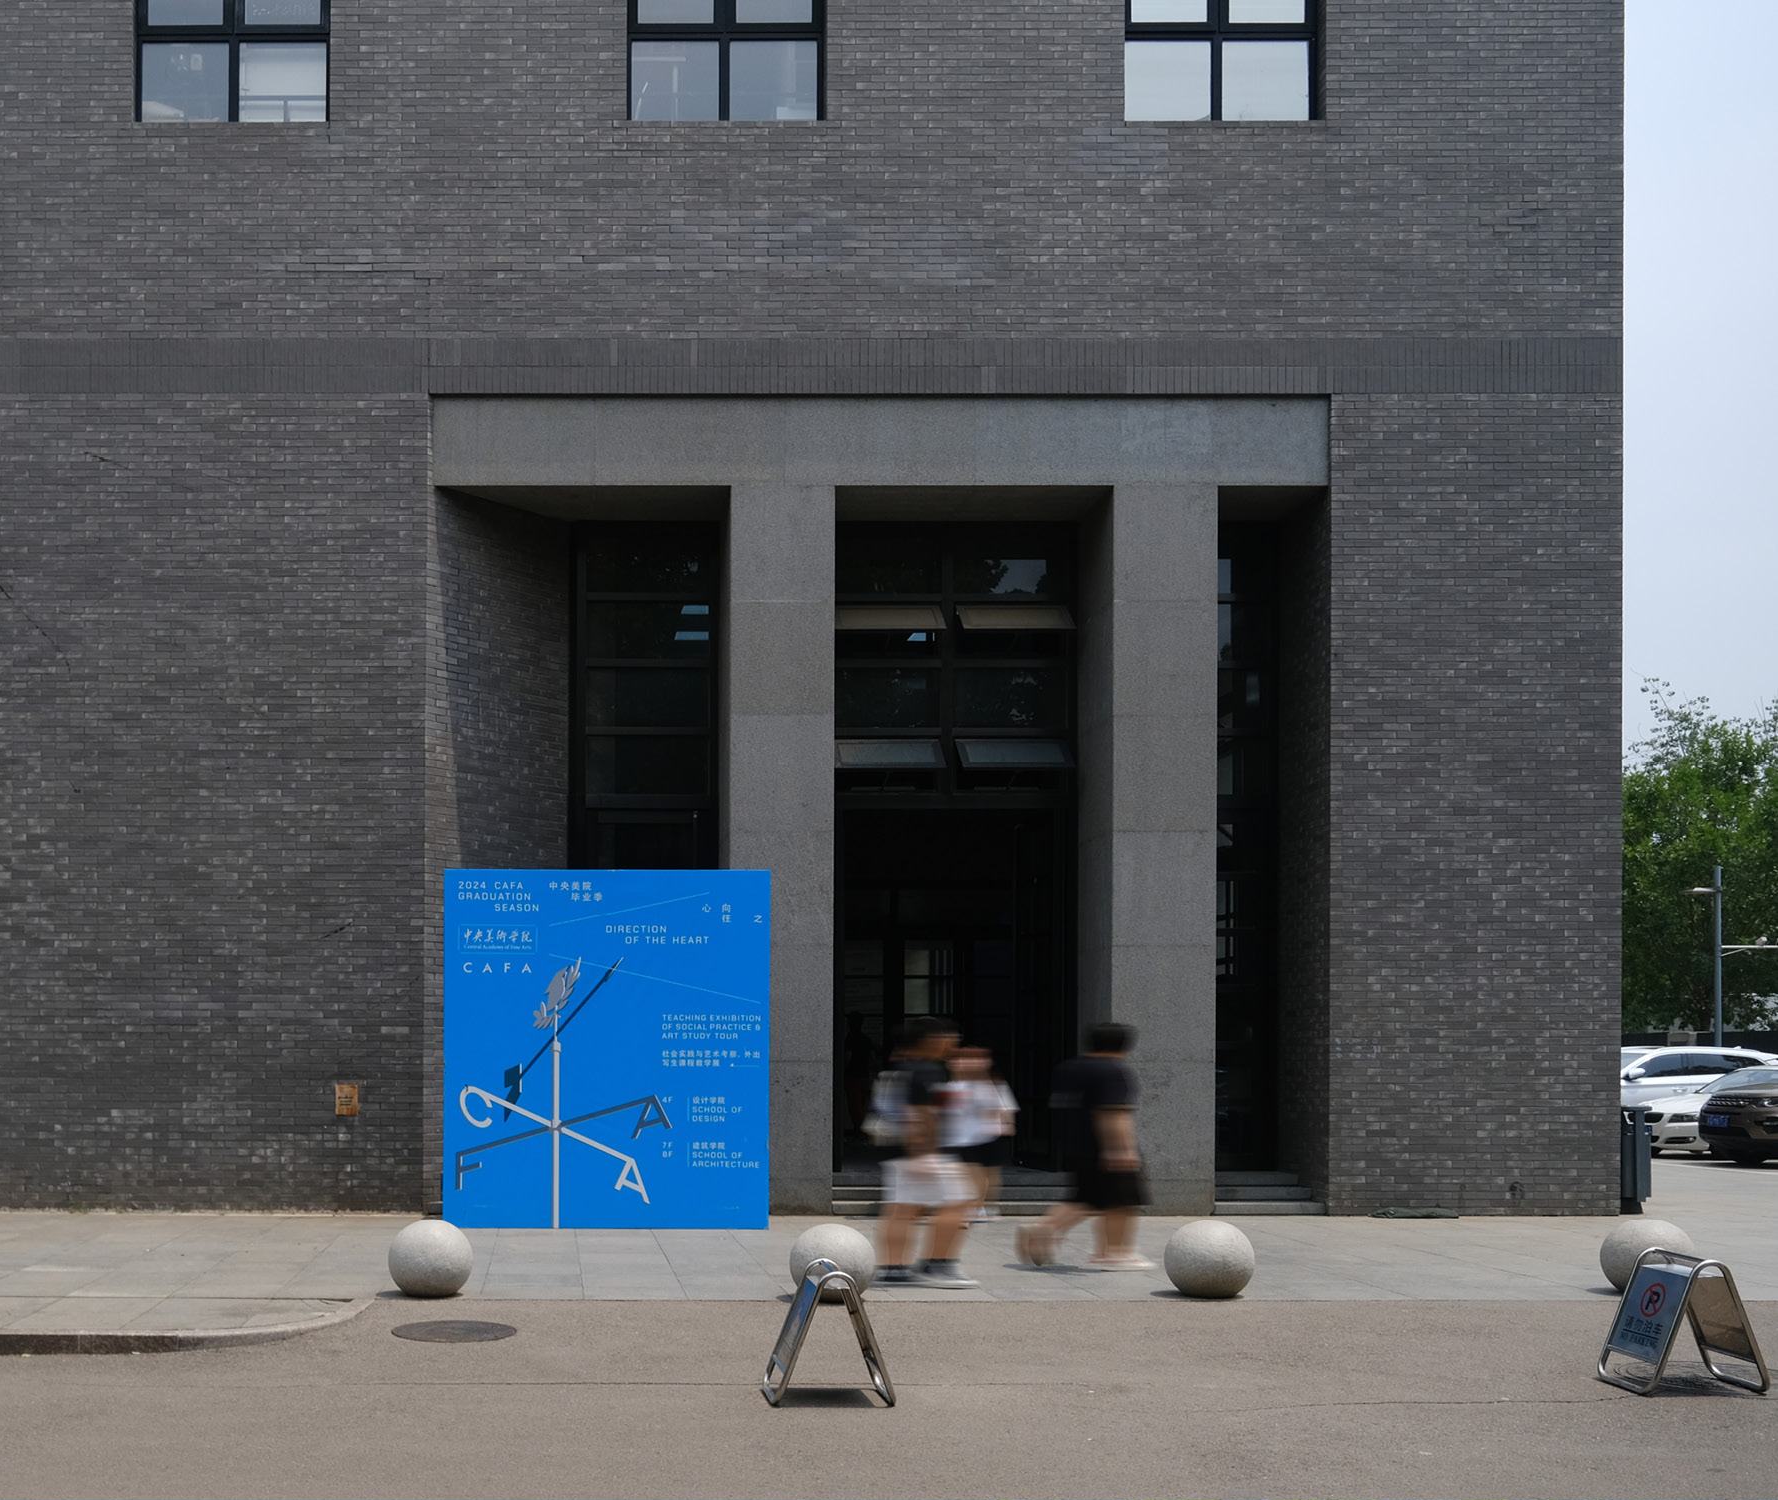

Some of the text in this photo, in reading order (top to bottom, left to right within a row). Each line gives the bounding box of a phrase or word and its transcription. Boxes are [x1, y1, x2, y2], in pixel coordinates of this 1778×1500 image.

[458, 881, 523, 890] 2024 CAFA
[549, 881, 592, 891] 中央美院
[458, 892, 531, 900] GRADUATION
[495, 904, 539, 912] SEASON
[606, 925, 667, 934] DIRECTION
[625, 936, 709, 944] OF THE HEART
[710, 1014, 761, 1022] EXHIBITION
[662, 1023, 672, 1031] OF
[675, 1023, 707, 1031] SOCIAL
